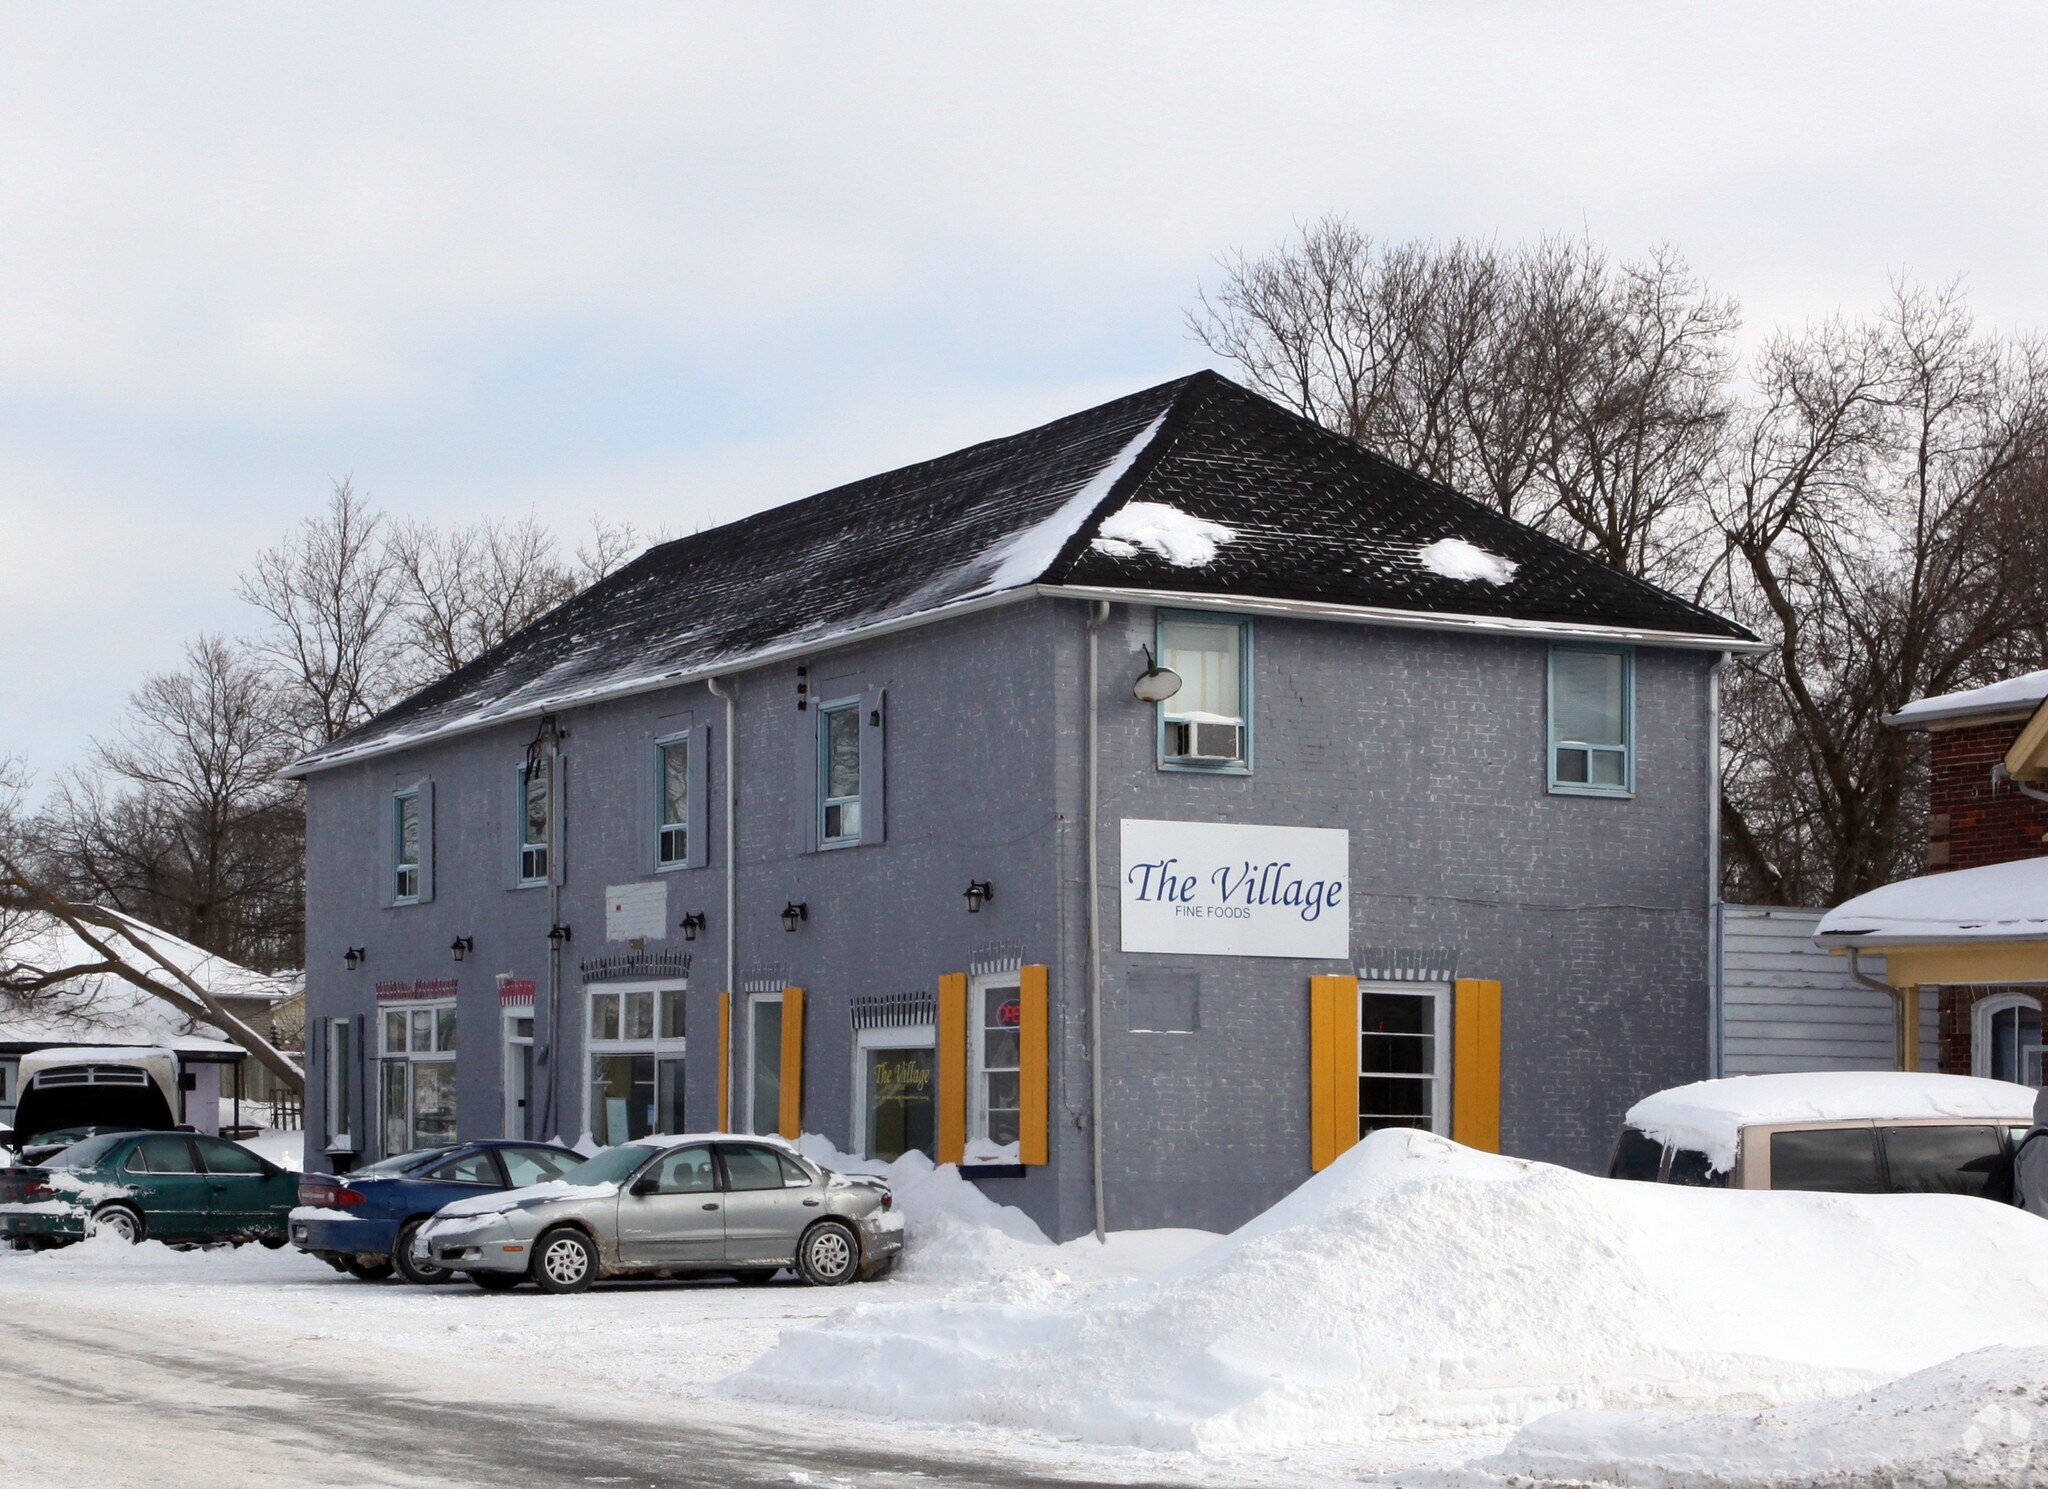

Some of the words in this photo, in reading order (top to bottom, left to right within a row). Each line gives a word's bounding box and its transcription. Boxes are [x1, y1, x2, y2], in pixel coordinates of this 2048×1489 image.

[1128, 858, 1197, 903] The
[1211, 861, 1343, 922] Village
[1175, 905, 1203, 918] FINE
[1207, 906, 1251, 919] FOODS
[999, 1005, 1020, 1023] OPE
[874, 1061, 892, 1084] The
[894, 1060, 930, 1091] Village
